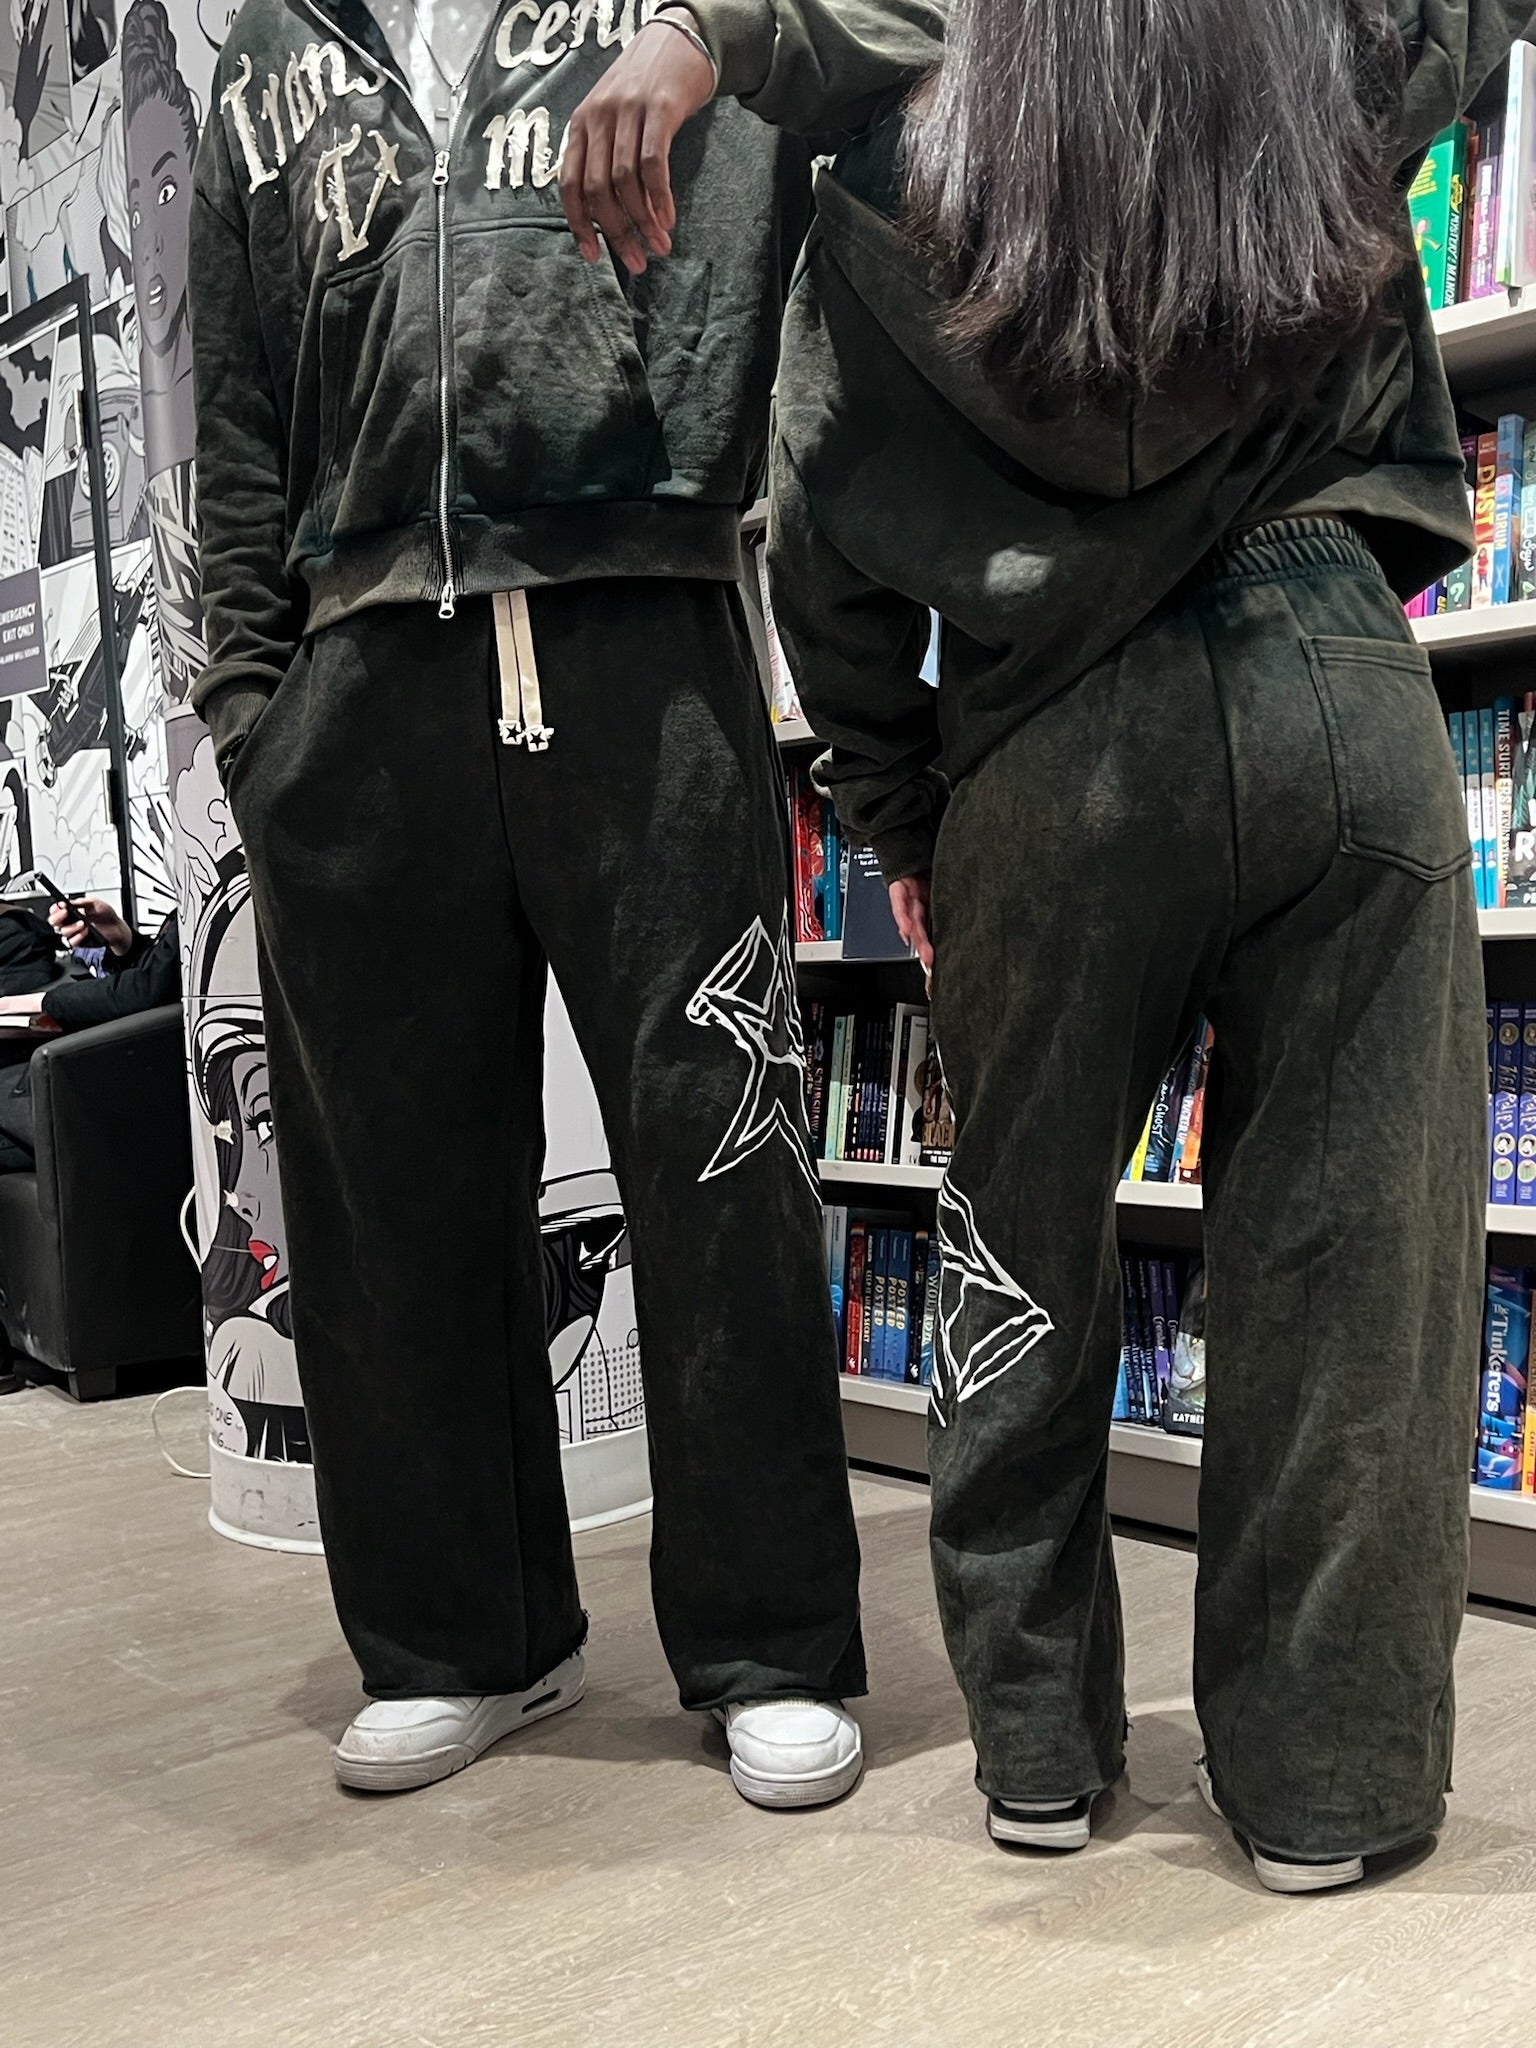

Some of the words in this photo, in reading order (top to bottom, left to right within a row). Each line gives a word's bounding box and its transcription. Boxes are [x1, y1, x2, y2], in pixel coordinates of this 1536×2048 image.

[1444, 263, 1457, 306] MANOR
[17, 622, 35, 639] ONLY
[1497, 709, 1510, 741] TIME
[1498, 744, 1511, 806] SURFERS
[1502, 810, 1511, 838] KEVIN
[1151, 1103, 1169, 1137] GHOST
[874, 1276, 886, 1327] POSTED
[886, 1277, 898, 1328] POSTED
[896, 1279, 907, 1330] POSTED
[862, 1317, 870, 1343] SECRET
[1486, 1316, 1509, 1413] Tinkerers
